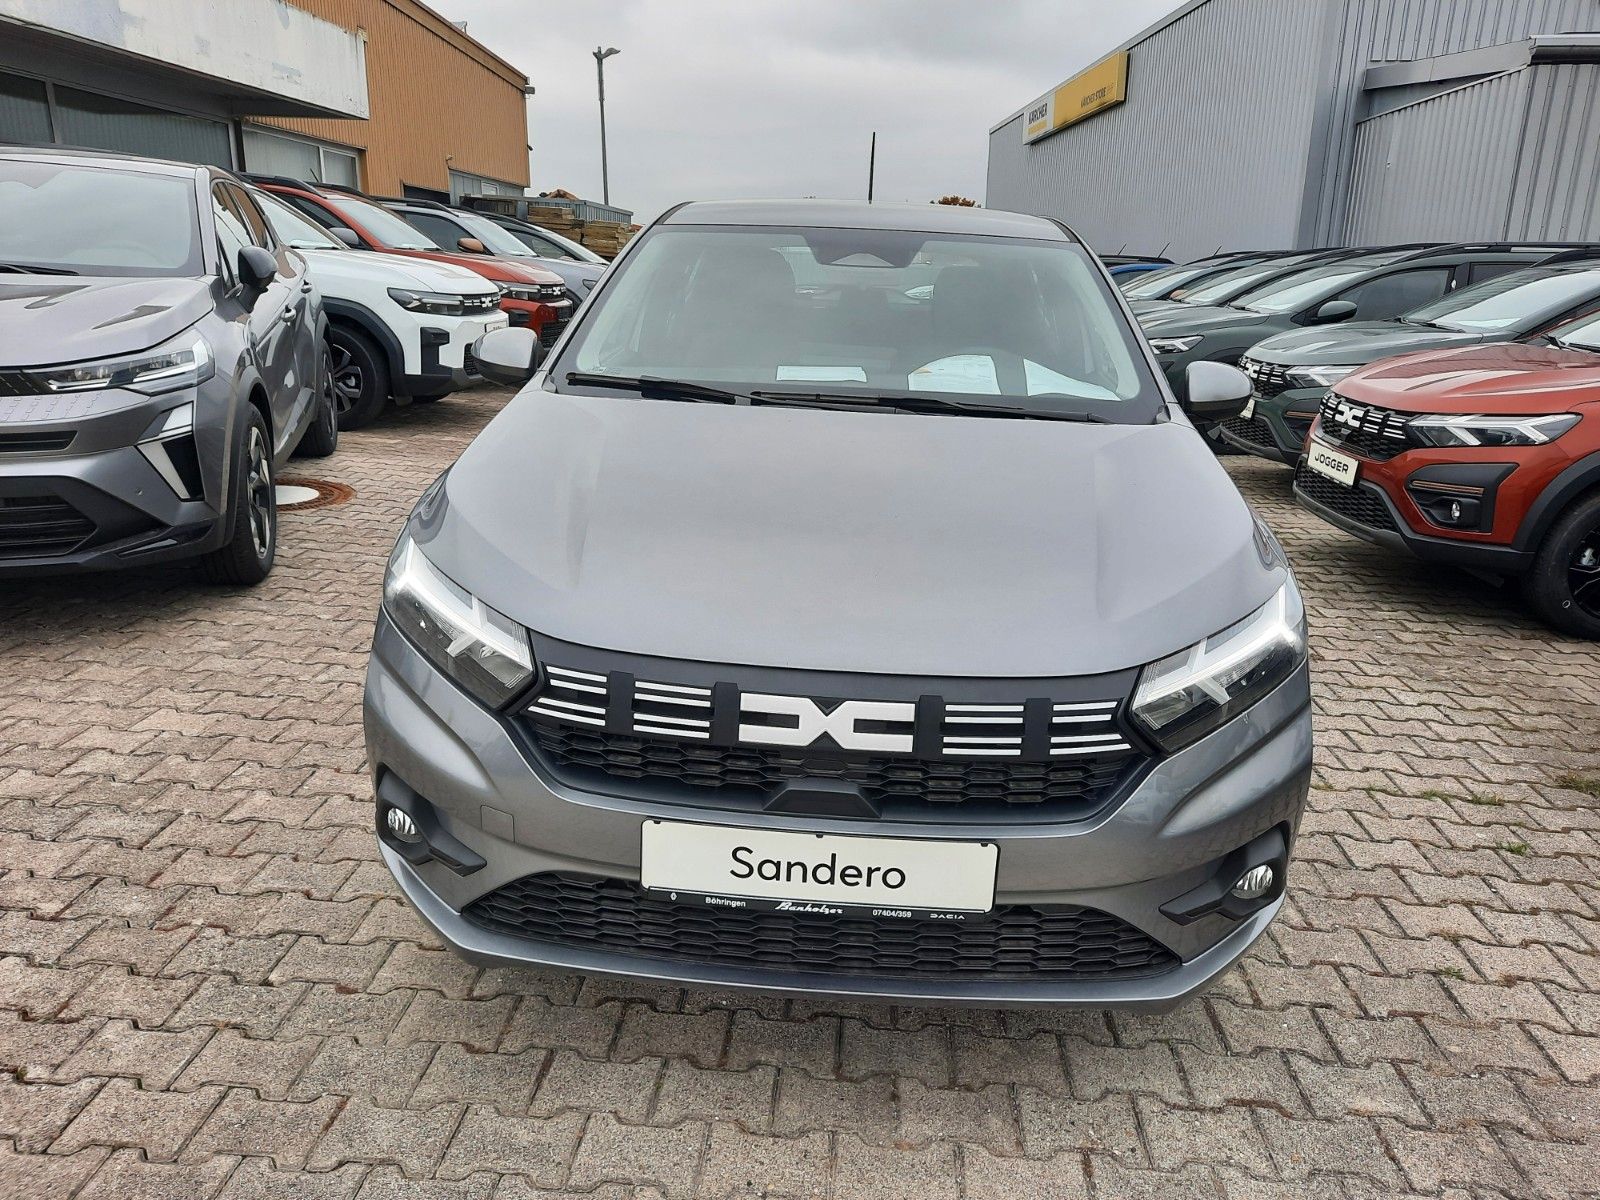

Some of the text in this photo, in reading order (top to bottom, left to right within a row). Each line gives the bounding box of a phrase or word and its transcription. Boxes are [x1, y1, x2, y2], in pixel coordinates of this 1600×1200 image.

[1314, 453, 1349, 474] JOGGER
[730, 846, 906, 889] Sandero
[705, 897, 746, 907] Böhringen
[872, 909, 912, 918] 07404/359
